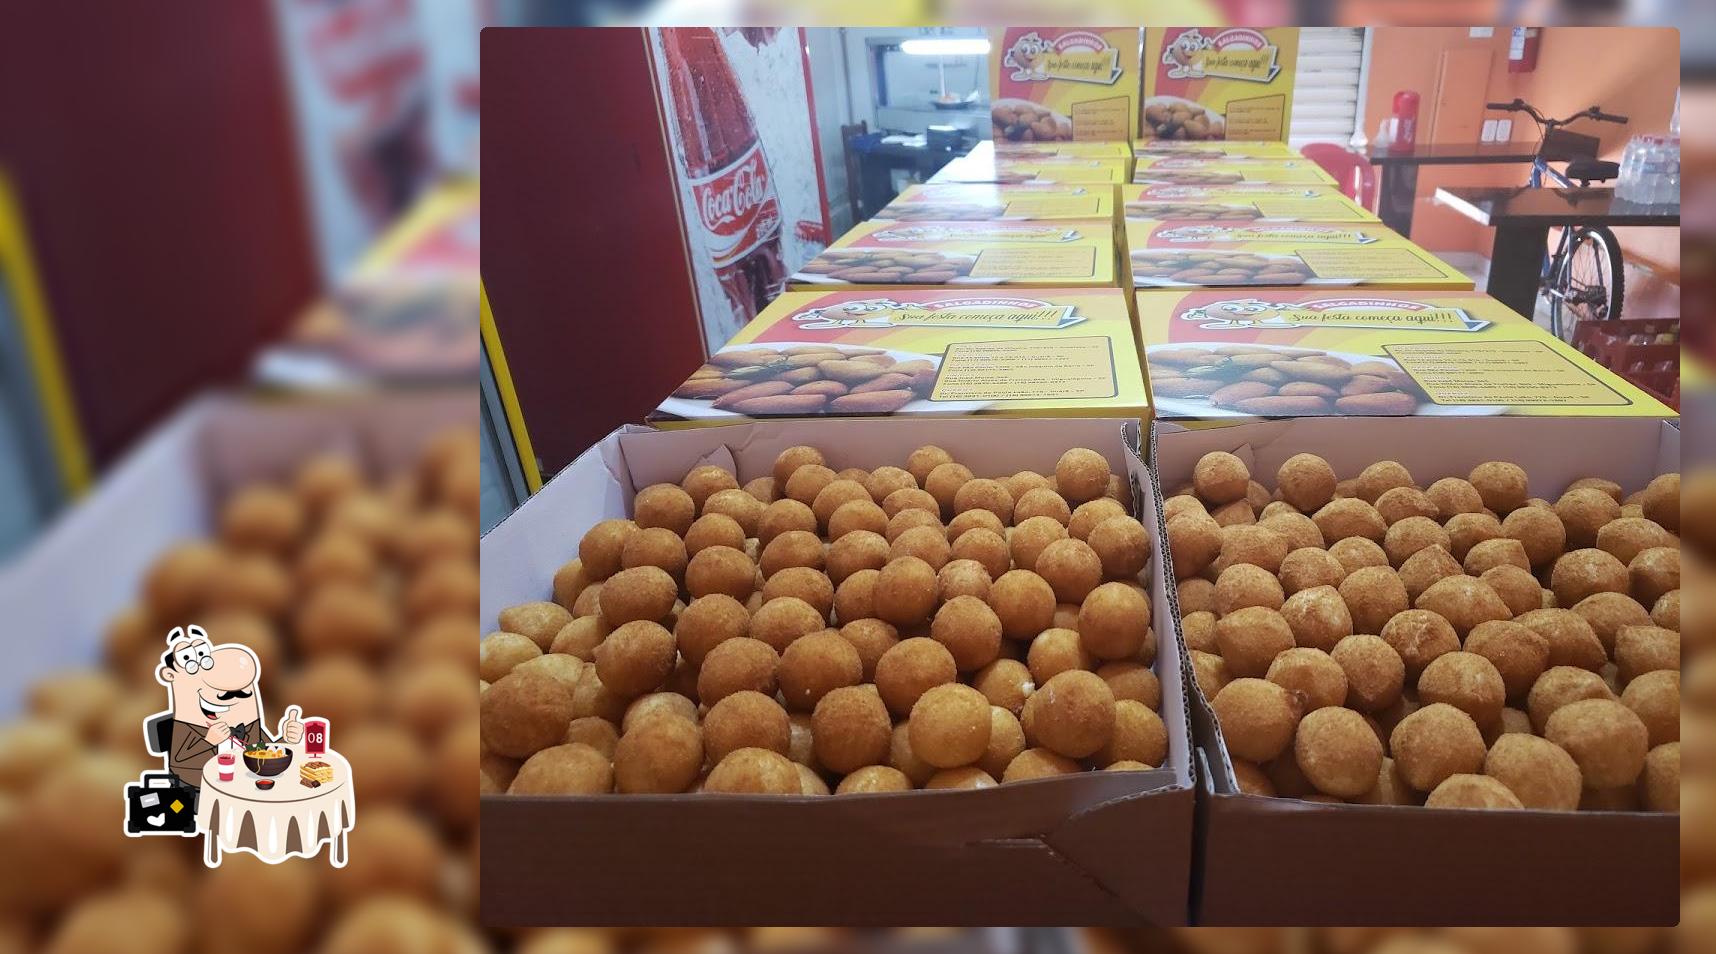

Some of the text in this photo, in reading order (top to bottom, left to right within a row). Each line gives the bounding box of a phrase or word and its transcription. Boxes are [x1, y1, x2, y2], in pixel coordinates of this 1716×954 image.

[702, 159, 767, 230] Coca-Cola
[899, 310, 1058, 323] Sua festa começa aqui!!!
[1292, 312, 1454, 325] Sua festa começa aqui!!!
